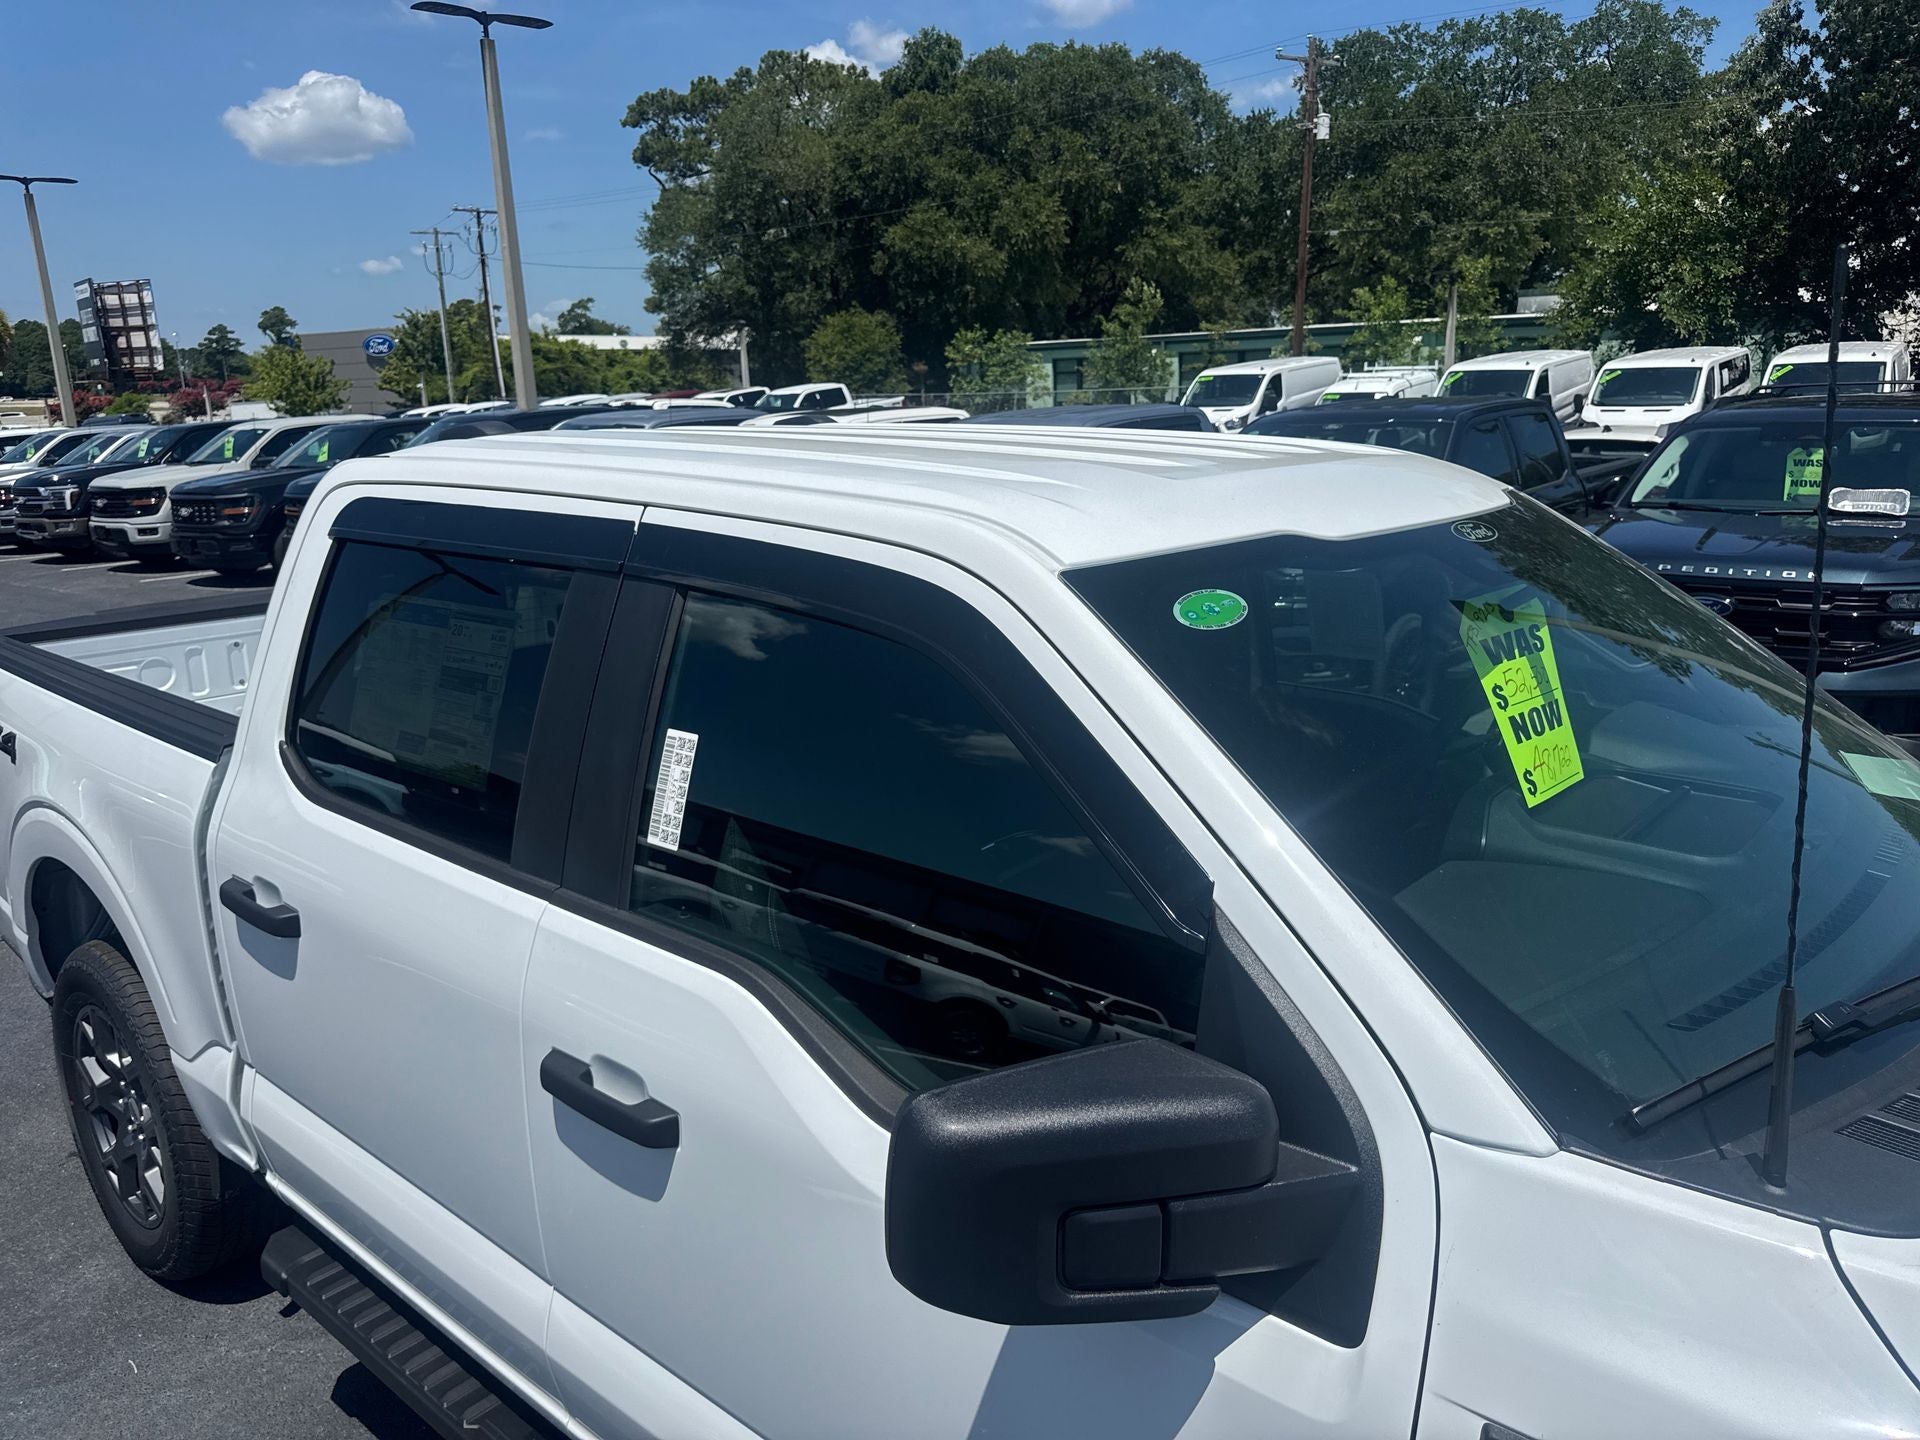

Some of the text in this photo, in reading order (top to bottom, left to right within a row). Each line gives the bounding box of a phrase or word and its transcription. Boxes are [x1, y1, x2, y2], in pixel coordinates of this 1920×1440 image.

[369, 338, 389, 353] Ford
[1793, 458, 1823, 468] WAS
[1790, 480, 1822, 488] NOW
[1457, 523, 1493, 541] Ford
[1478, 623, 1545, 667] WAS
[1508, 698, 1563, 745] NOW
